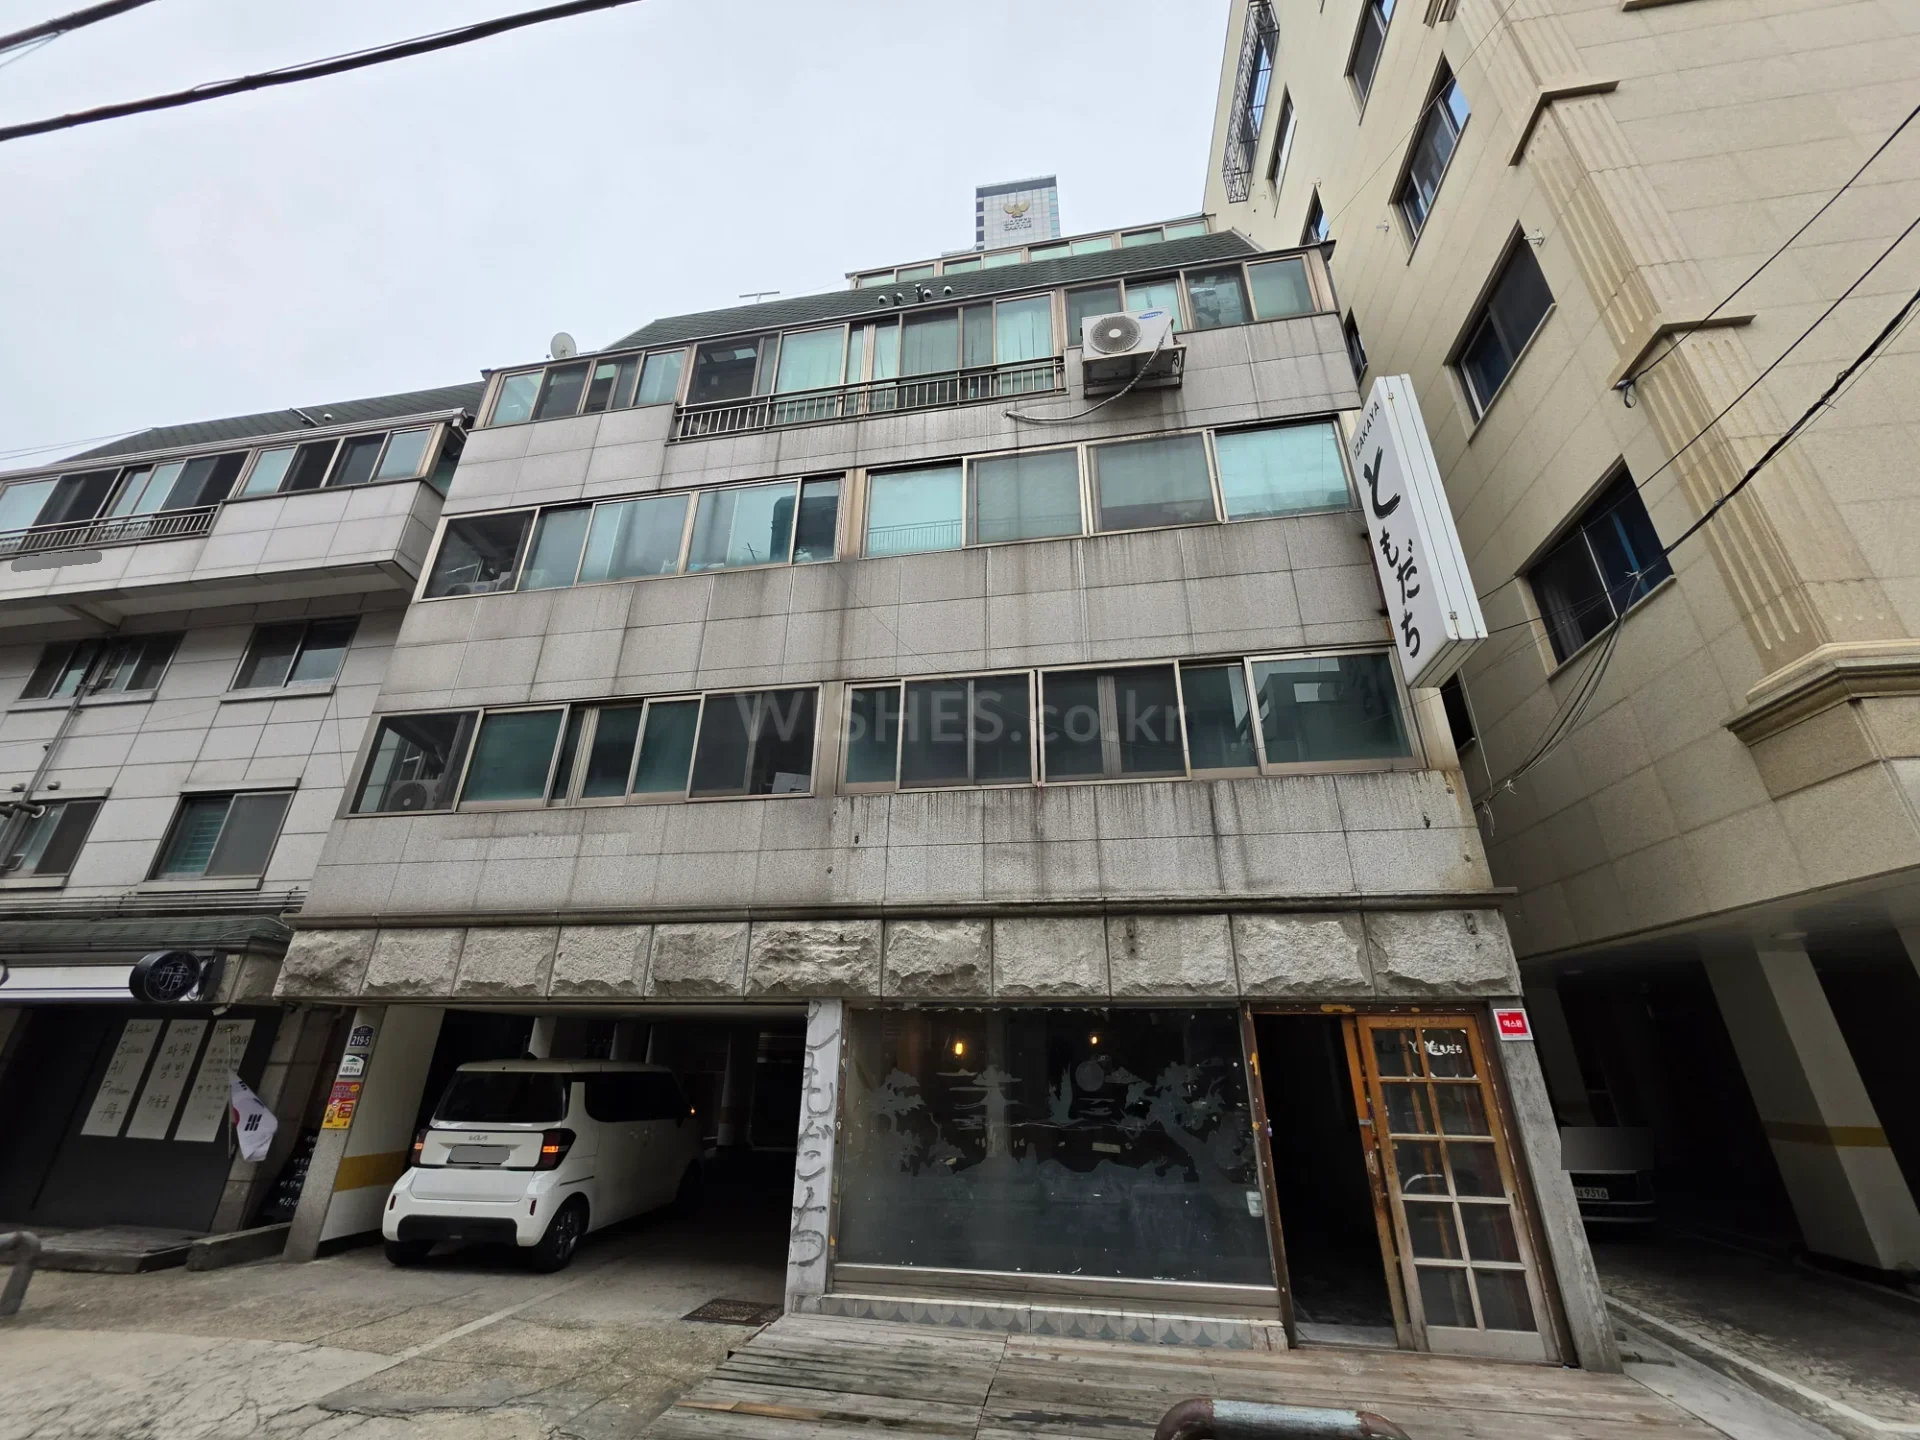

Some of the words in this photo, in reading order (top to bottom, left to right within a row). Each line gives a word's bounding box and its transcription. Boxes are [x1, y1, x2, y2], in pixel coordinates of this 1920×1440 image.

[1354, 400, 1380, 460] IZAKAYA
[1363, 445, 1421, 658] ともだち
[216, 1023, 241, 1034] HAPPY
[1502, 1019, 1523, 1028] 에스원
[351, 1035, 370, 1045] 219-5
[165, 1042, 193, 1056] 파워
[160, 1061, 185, 1079] 냉방
[468, 1133, 488, 1141] KIA
[1583, 1187, 1607, 1197] 9316
